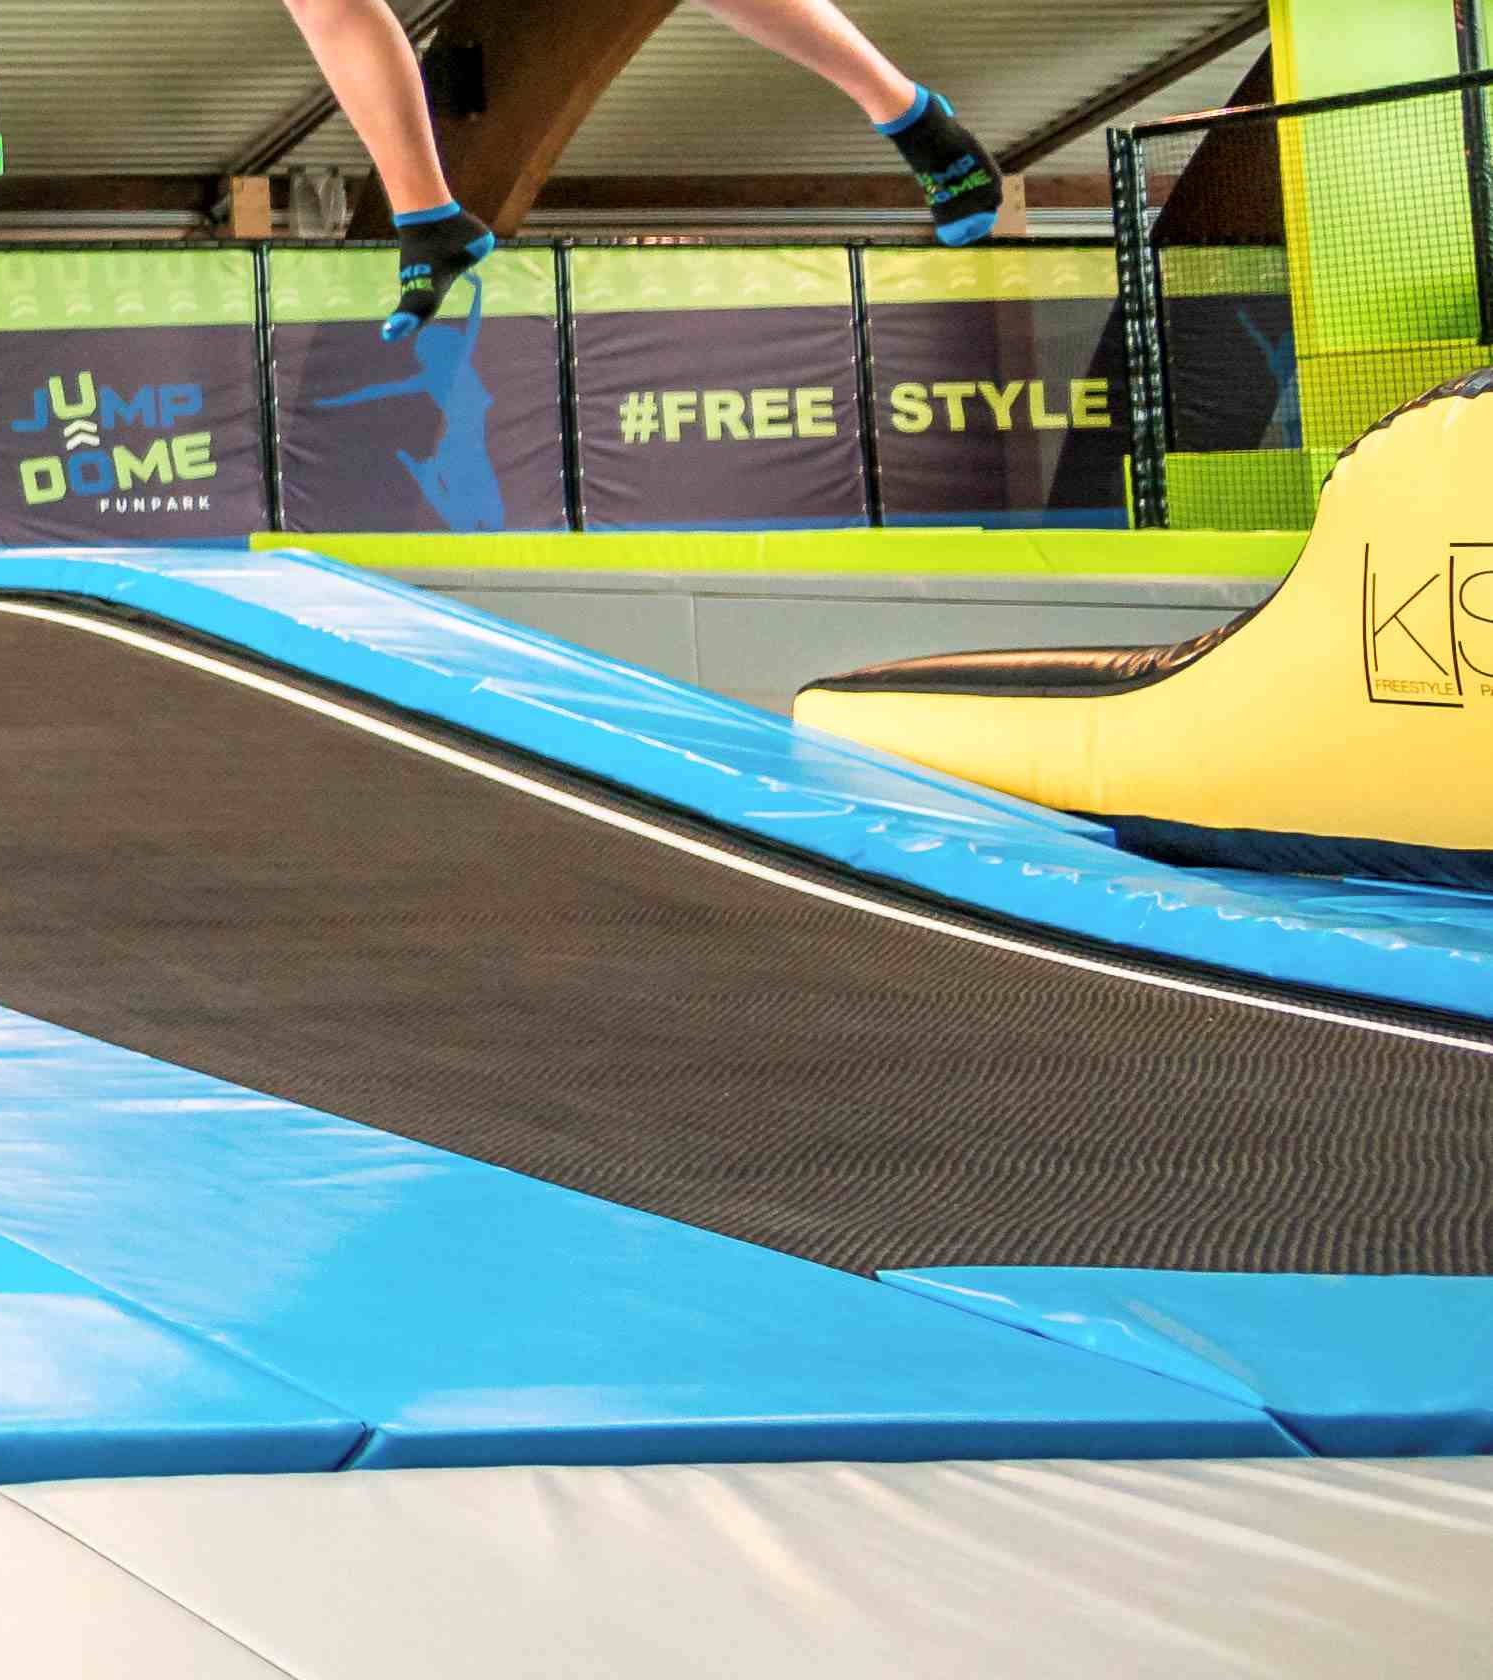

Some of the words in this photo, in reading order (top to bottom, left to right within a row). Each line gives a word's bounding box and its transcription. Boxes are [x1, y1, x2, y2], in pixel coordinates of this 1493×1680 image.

[11, 370, 203, 432] JUMP
[620, 386, 837, 444] #FREE
[889, 378, 1112, 435] STYLE
[20, 431, 217, 505] DOME
[98, 496, 211, 513] FUNPARK
[1375, 678, 1456, 696] FREESTYLE
